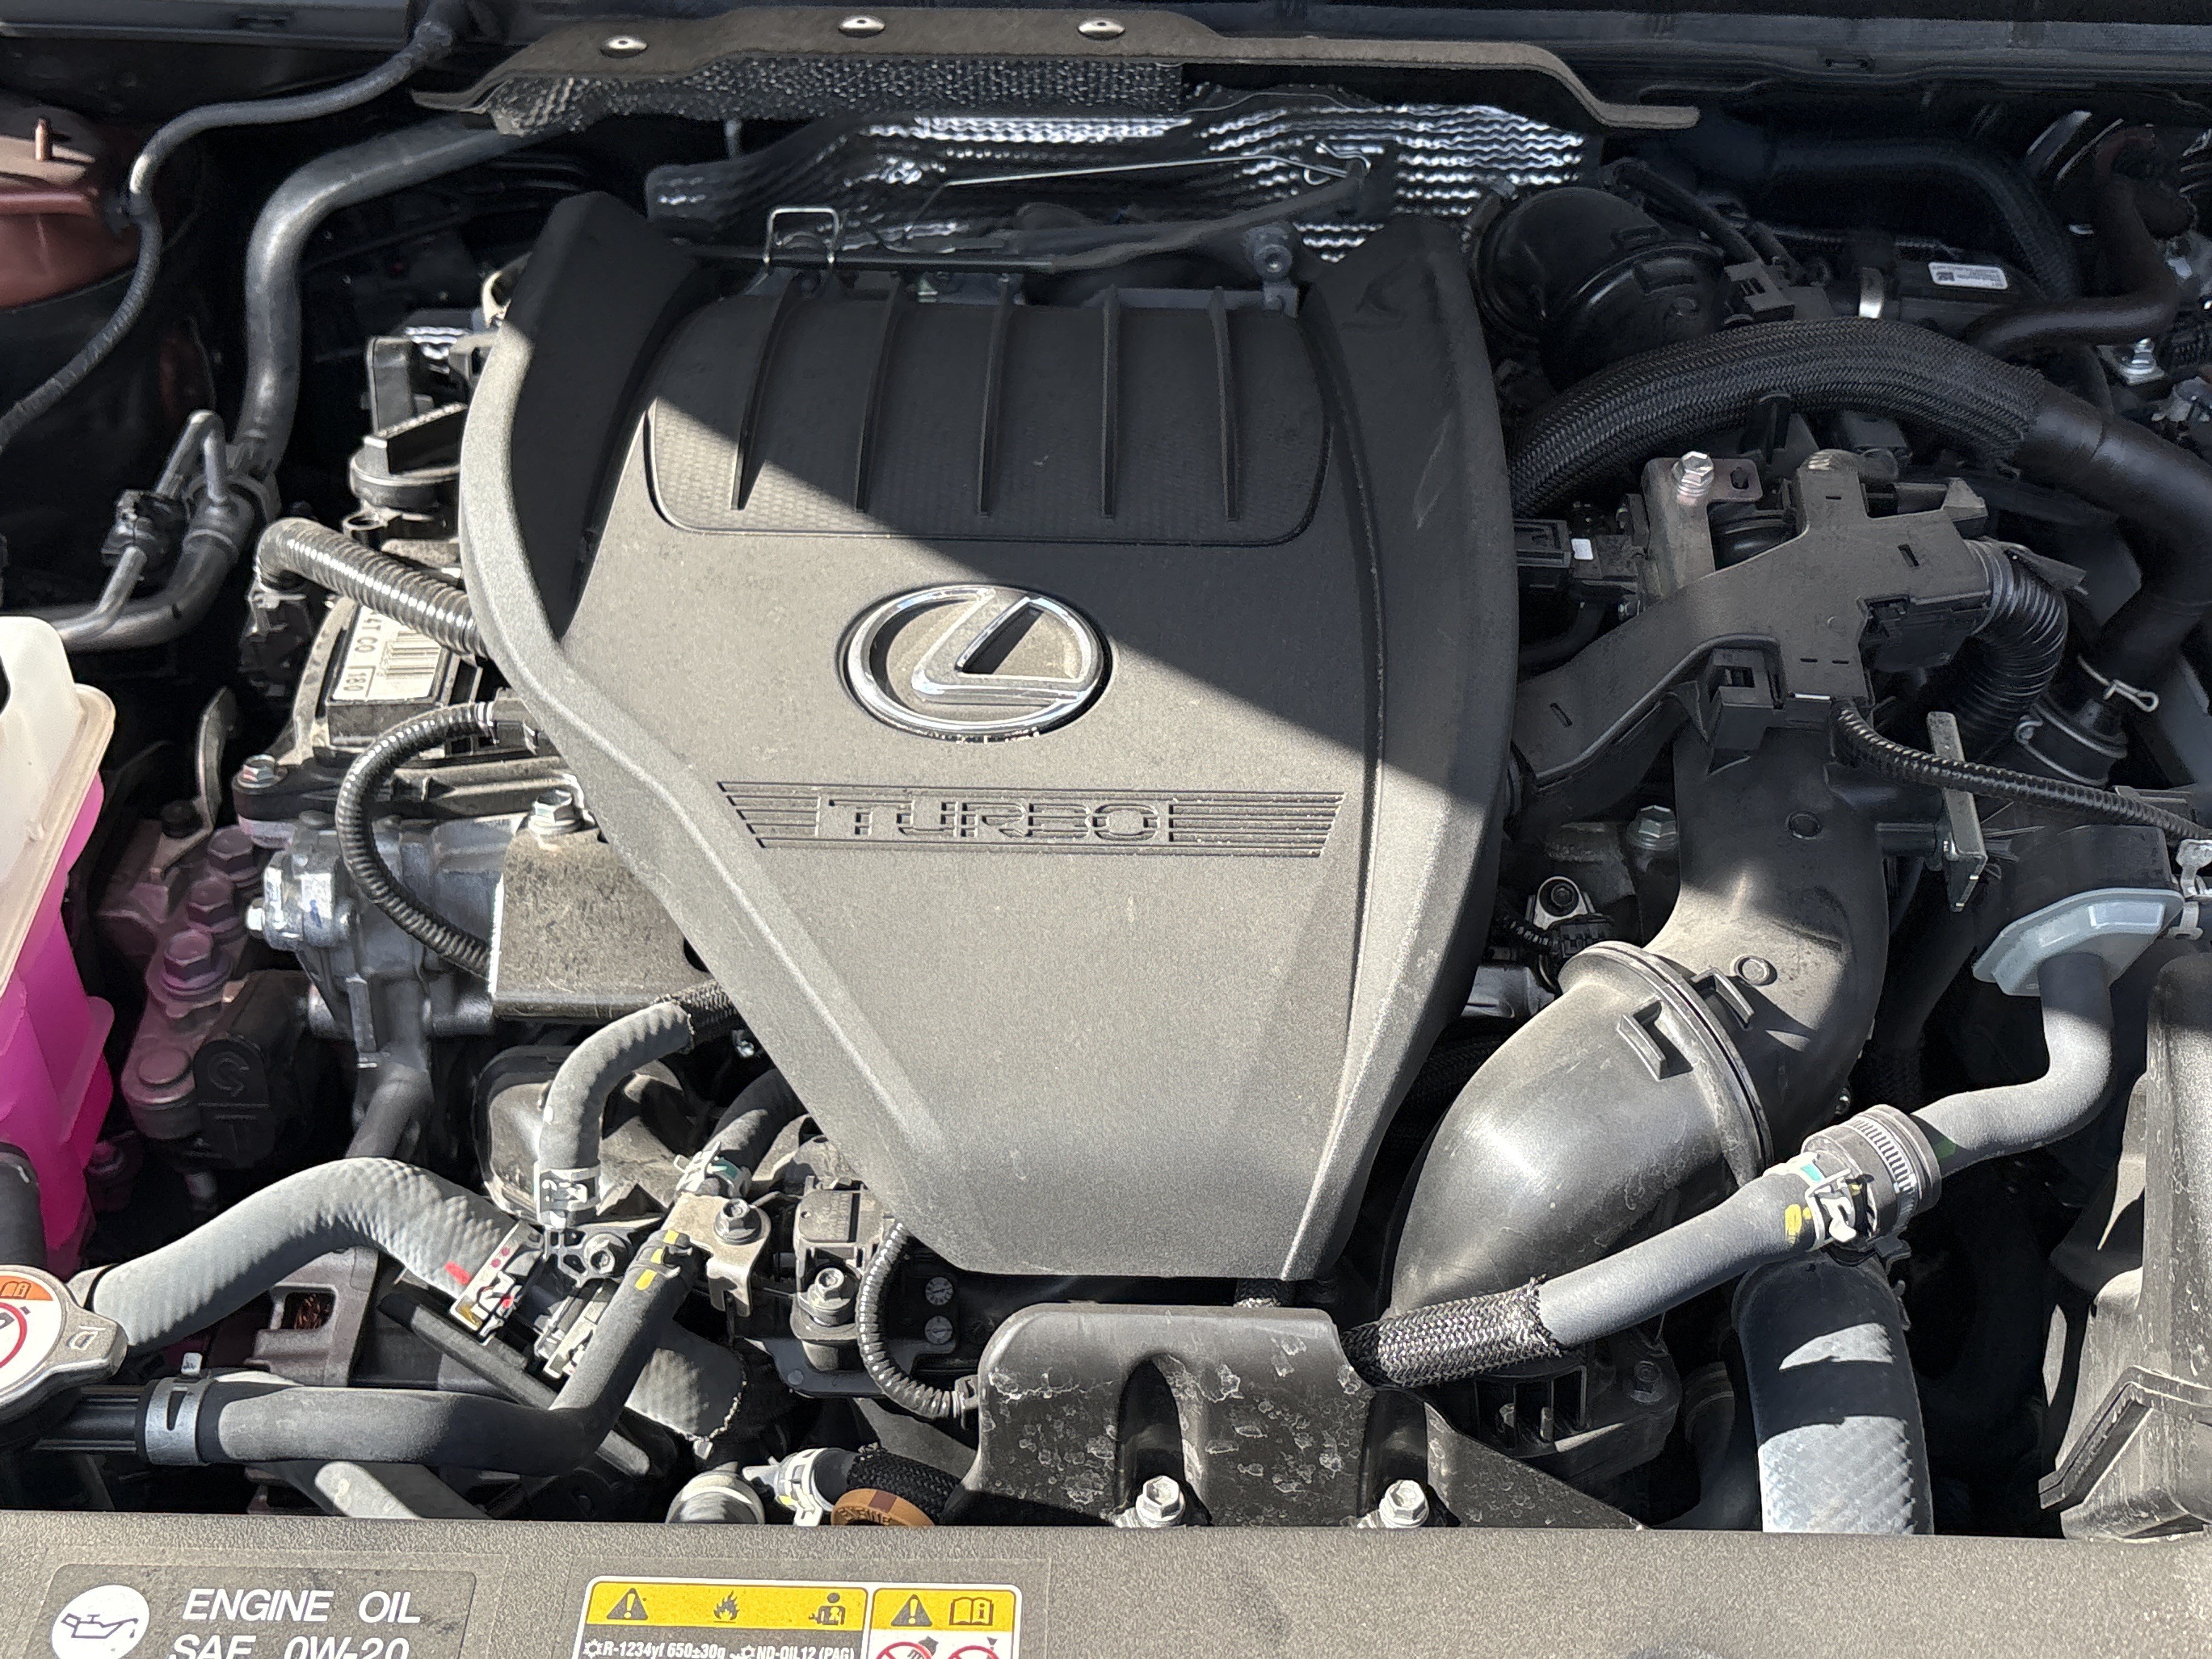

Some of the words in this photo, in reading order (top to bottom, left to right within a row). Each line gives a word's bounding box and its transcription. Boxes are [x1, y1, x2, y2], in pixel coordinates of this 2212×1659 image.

[343, 673, 366, 691] 180
[827, 798, 1161, 840] TURBO
[182, 1588, 334, 1622] ENGINE
[358, 1590, 421, 1623] OIL
[283, 1635, 410, 1659] 0W-20
